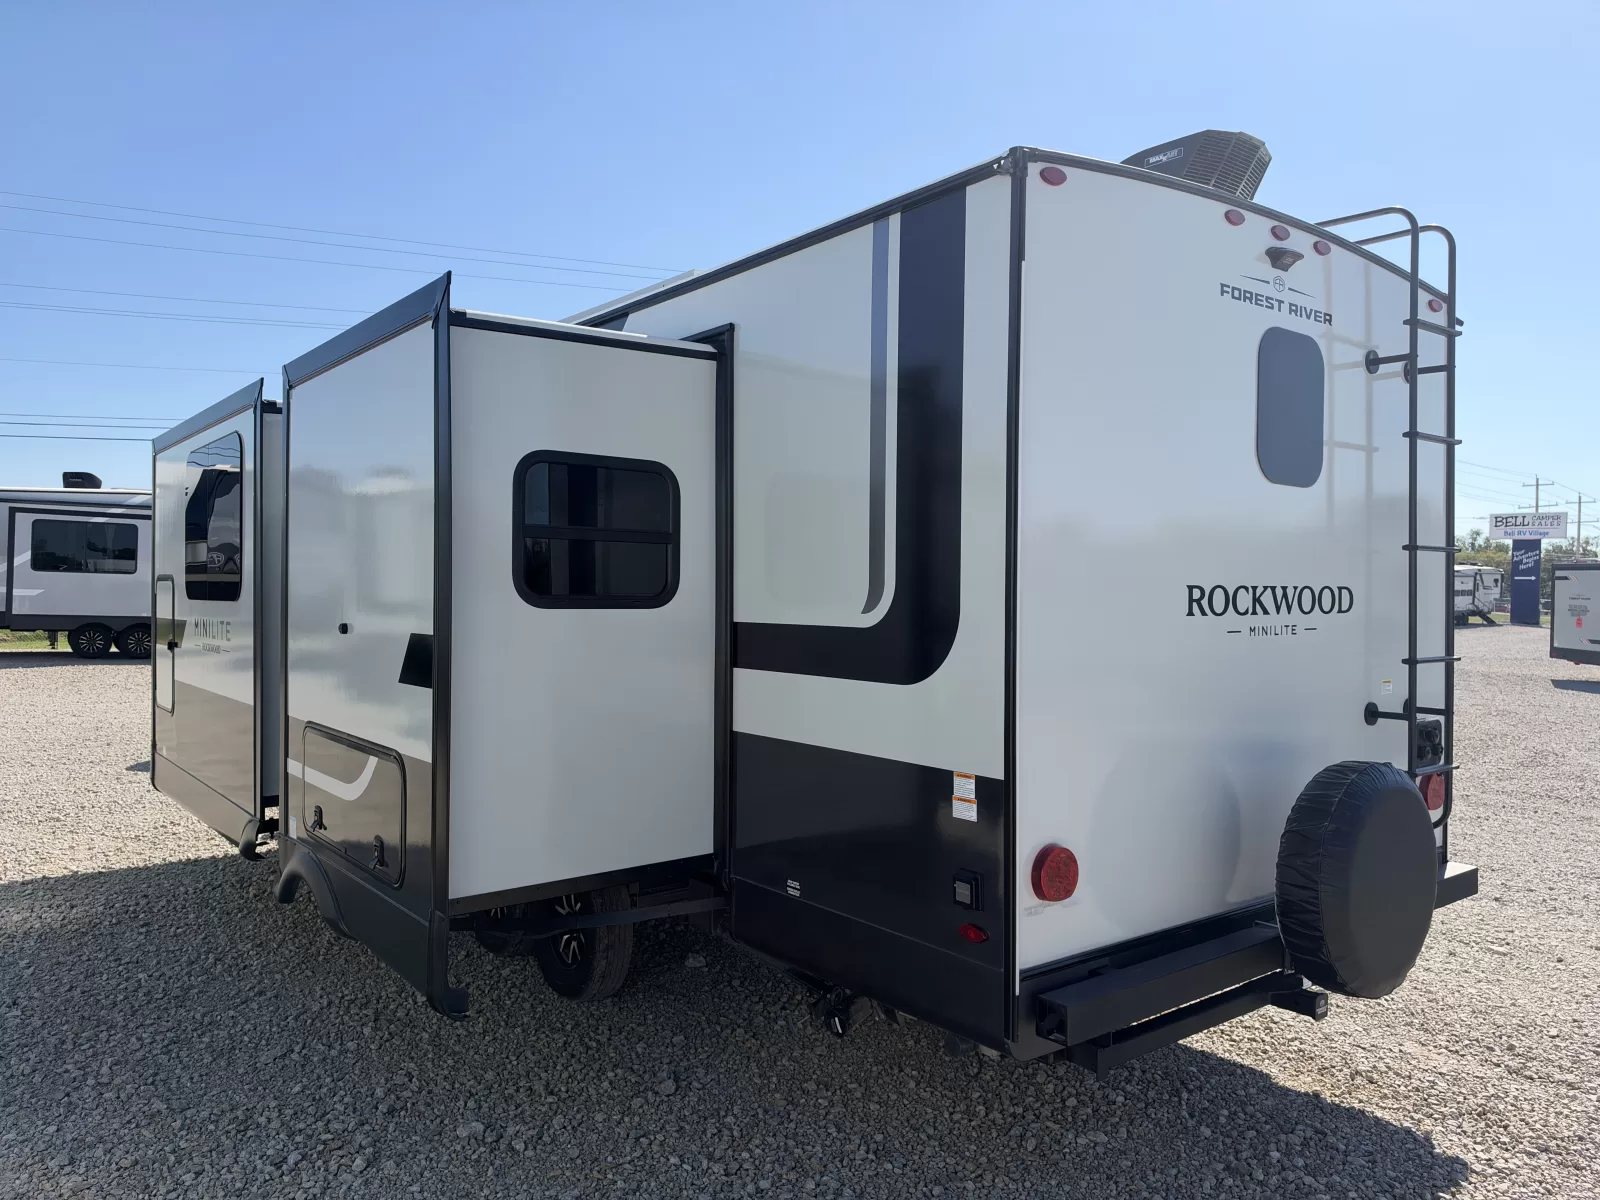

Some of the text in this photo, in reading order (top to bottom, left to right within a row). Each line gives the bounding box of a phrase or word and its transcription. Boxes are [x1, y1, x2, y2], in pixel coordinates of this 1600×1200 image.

[1220, 282, 1333, 327] FOREST RIVER
[1494, 516, 1530, 527] BELL
[1185, 584, 1354, 617] ROCKWOOD
[194, 617, 232, 642] MINILITE
[1249, 624, 1298, 637] MINILITE
